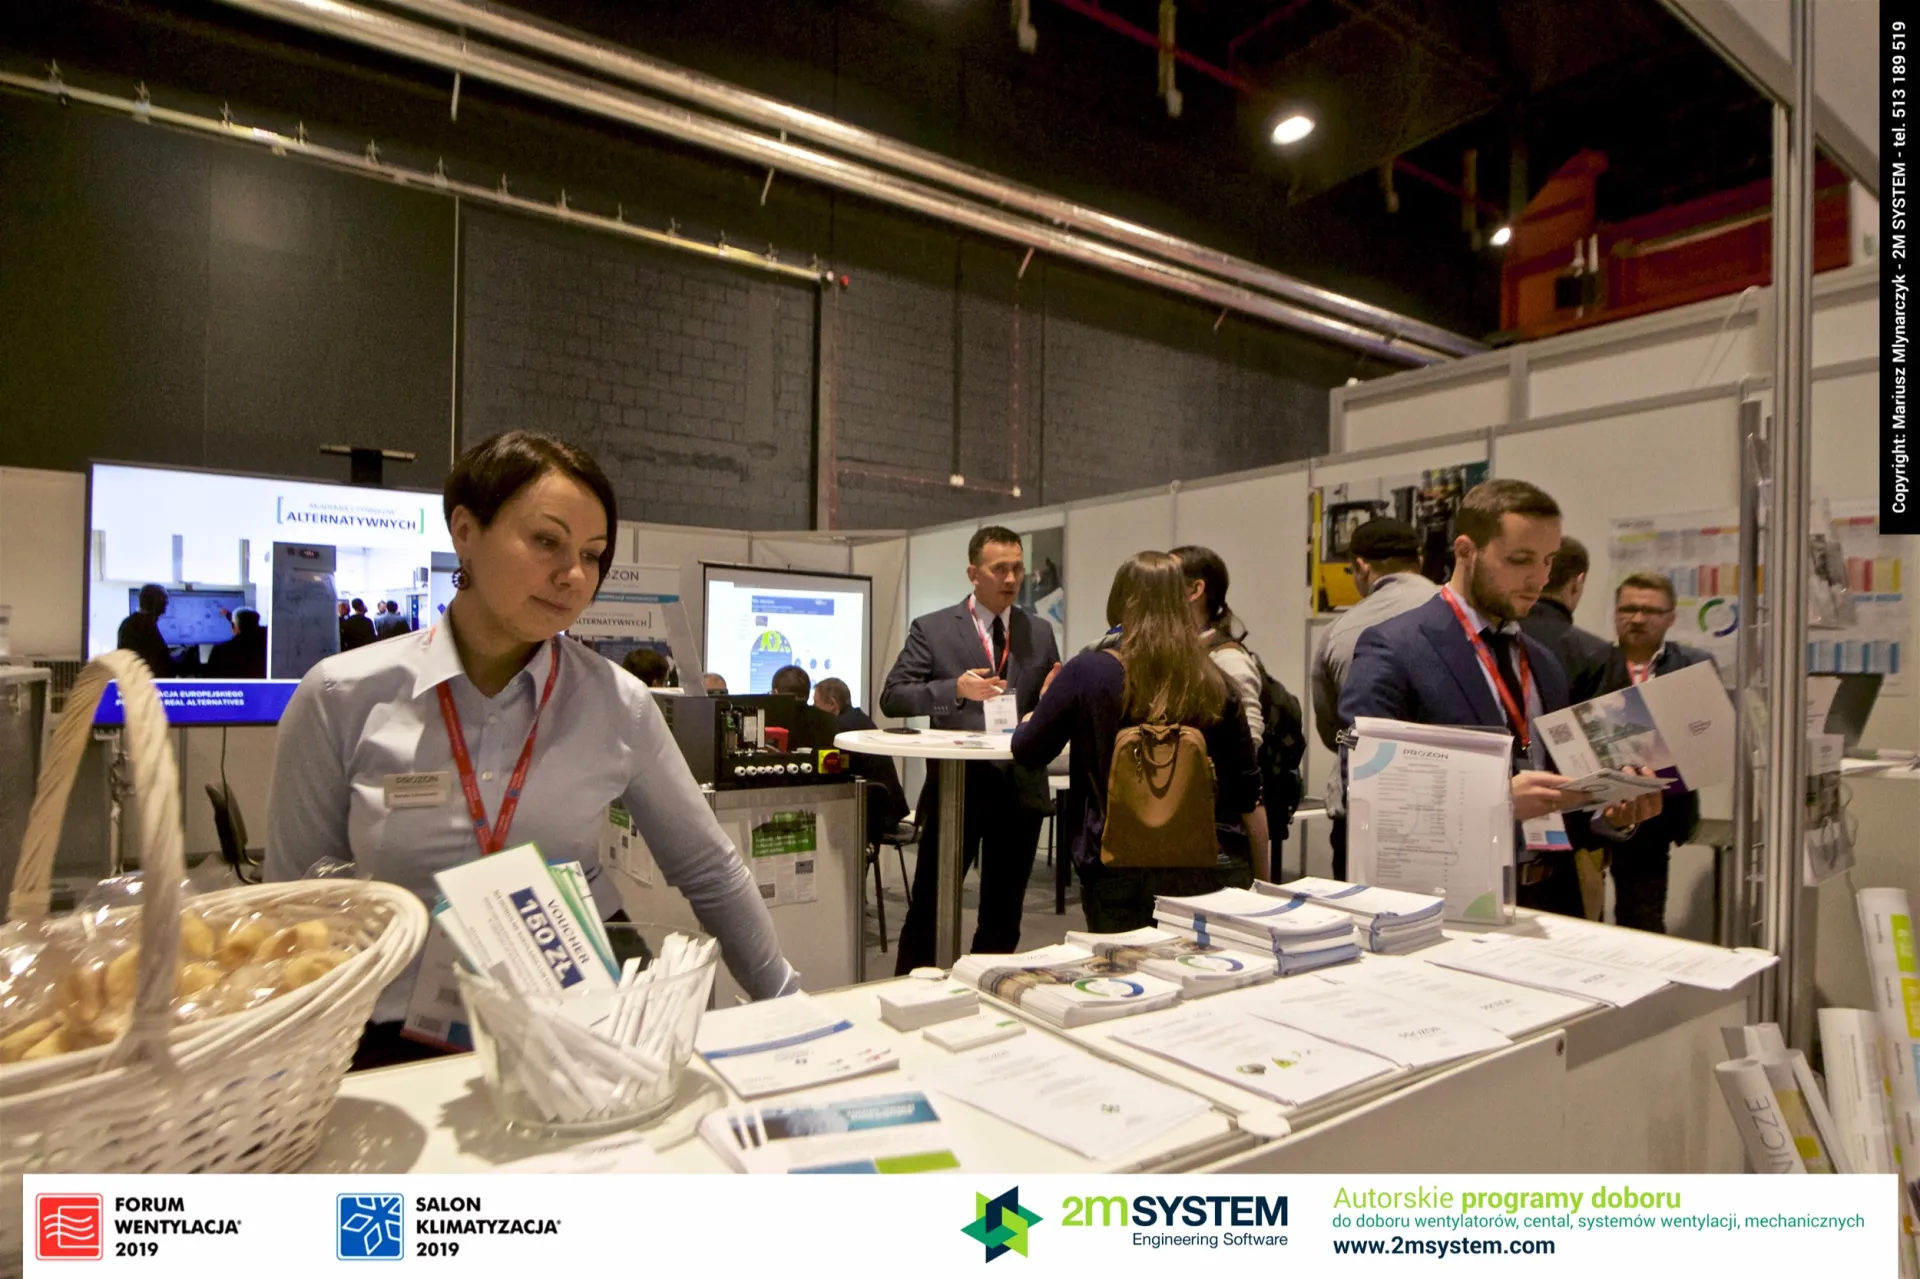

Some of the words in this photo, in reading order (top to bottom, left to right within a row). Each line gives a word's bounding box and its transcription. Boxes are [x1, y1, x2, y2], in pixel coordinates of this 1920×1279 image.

[287, 511, 417, 531] ALTERNATYWNYCH
[1403, 748, 1449, 760] PROZON
[519, 898, 556, 946] 150
[547, 898, 590, 965] VOUCHER
